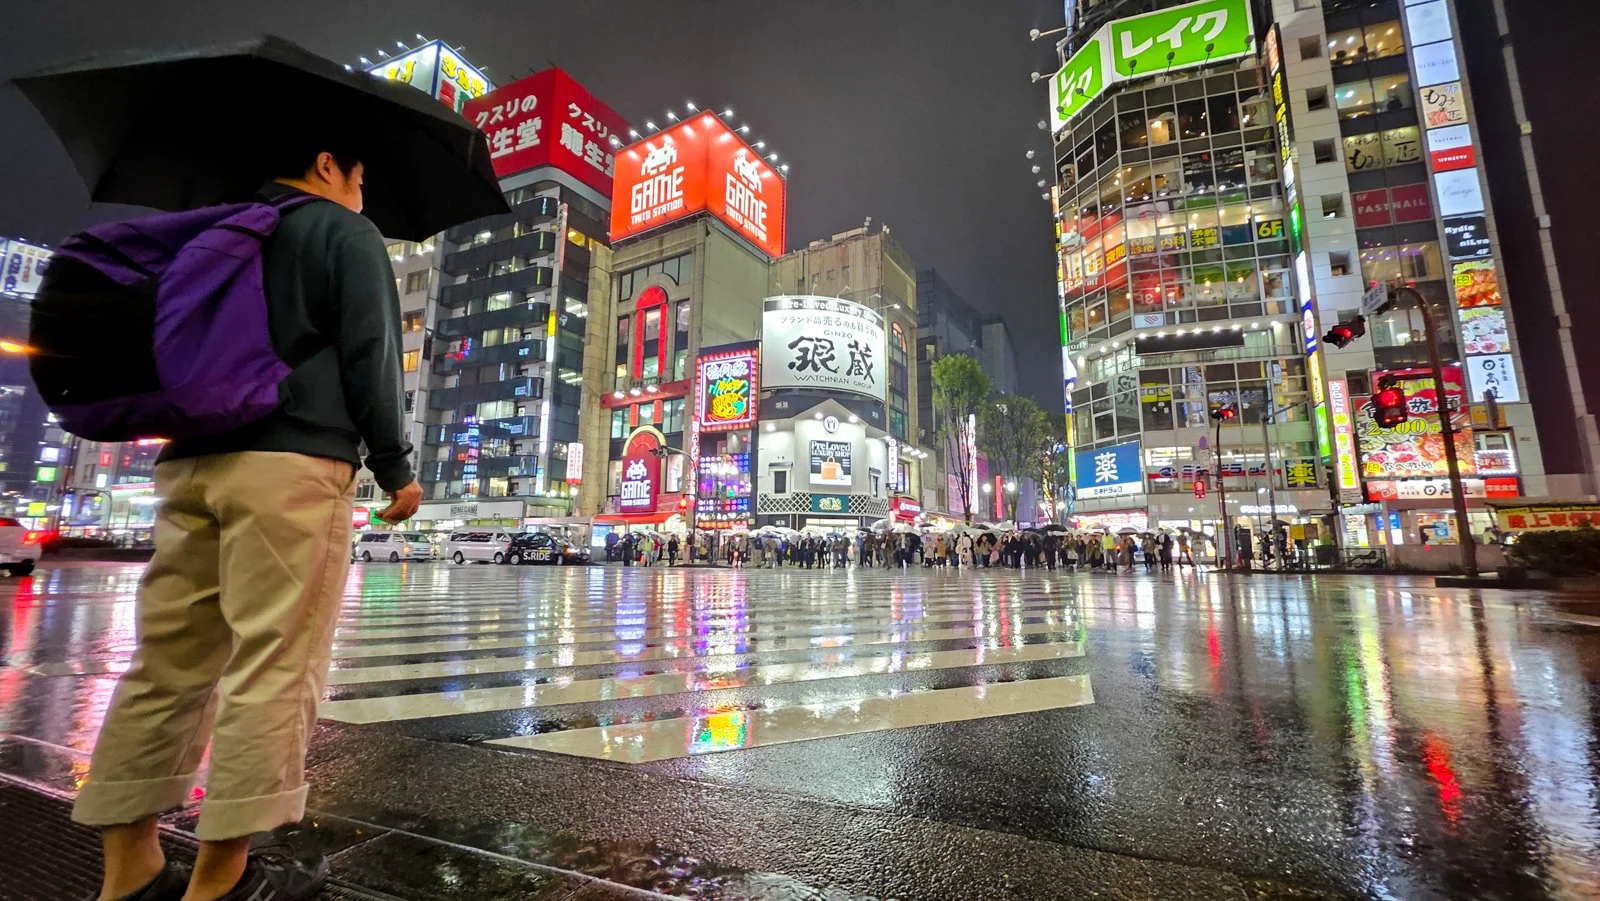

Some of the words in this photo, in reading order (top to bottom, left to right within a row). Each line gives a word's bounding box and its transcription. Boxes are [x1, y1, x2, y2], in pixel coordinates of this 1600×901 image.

[1120, 8, 1228, 59] レイク
[1060, 65, 1093, 108] レイク
[475, 94, 538, 130] クスリの
[568, 102, 620, 148] クスリの
[485, 116, 542, 159] 生堂
[631, 166, 685, 214] GAME
[725, 172, 768, 232] GAME
[631, 211, 651, 225] TAITO
[652, 198, 683, 218] STATION
[725, 204, 743, 225] TAITO
[1357, 198, 1426, 216] FASTNAIL
[1258, 220, 1284, 238] 6F
[823, 329, 853, 340] GINZO
[788, 336, 875, 384] 銀蔵
[793, 374, 850, 385] WATCHNIAN
[853, 380, 872, 390] GROUP
[1094, 451, 1120, 483] 薬
[1286, 461, 1317, 488] 薬
[621, 480, 651, 500] GAME
[1240, 504, 1298, 514] PANDRA
[523, 550, 551, 561] S.RIDE
